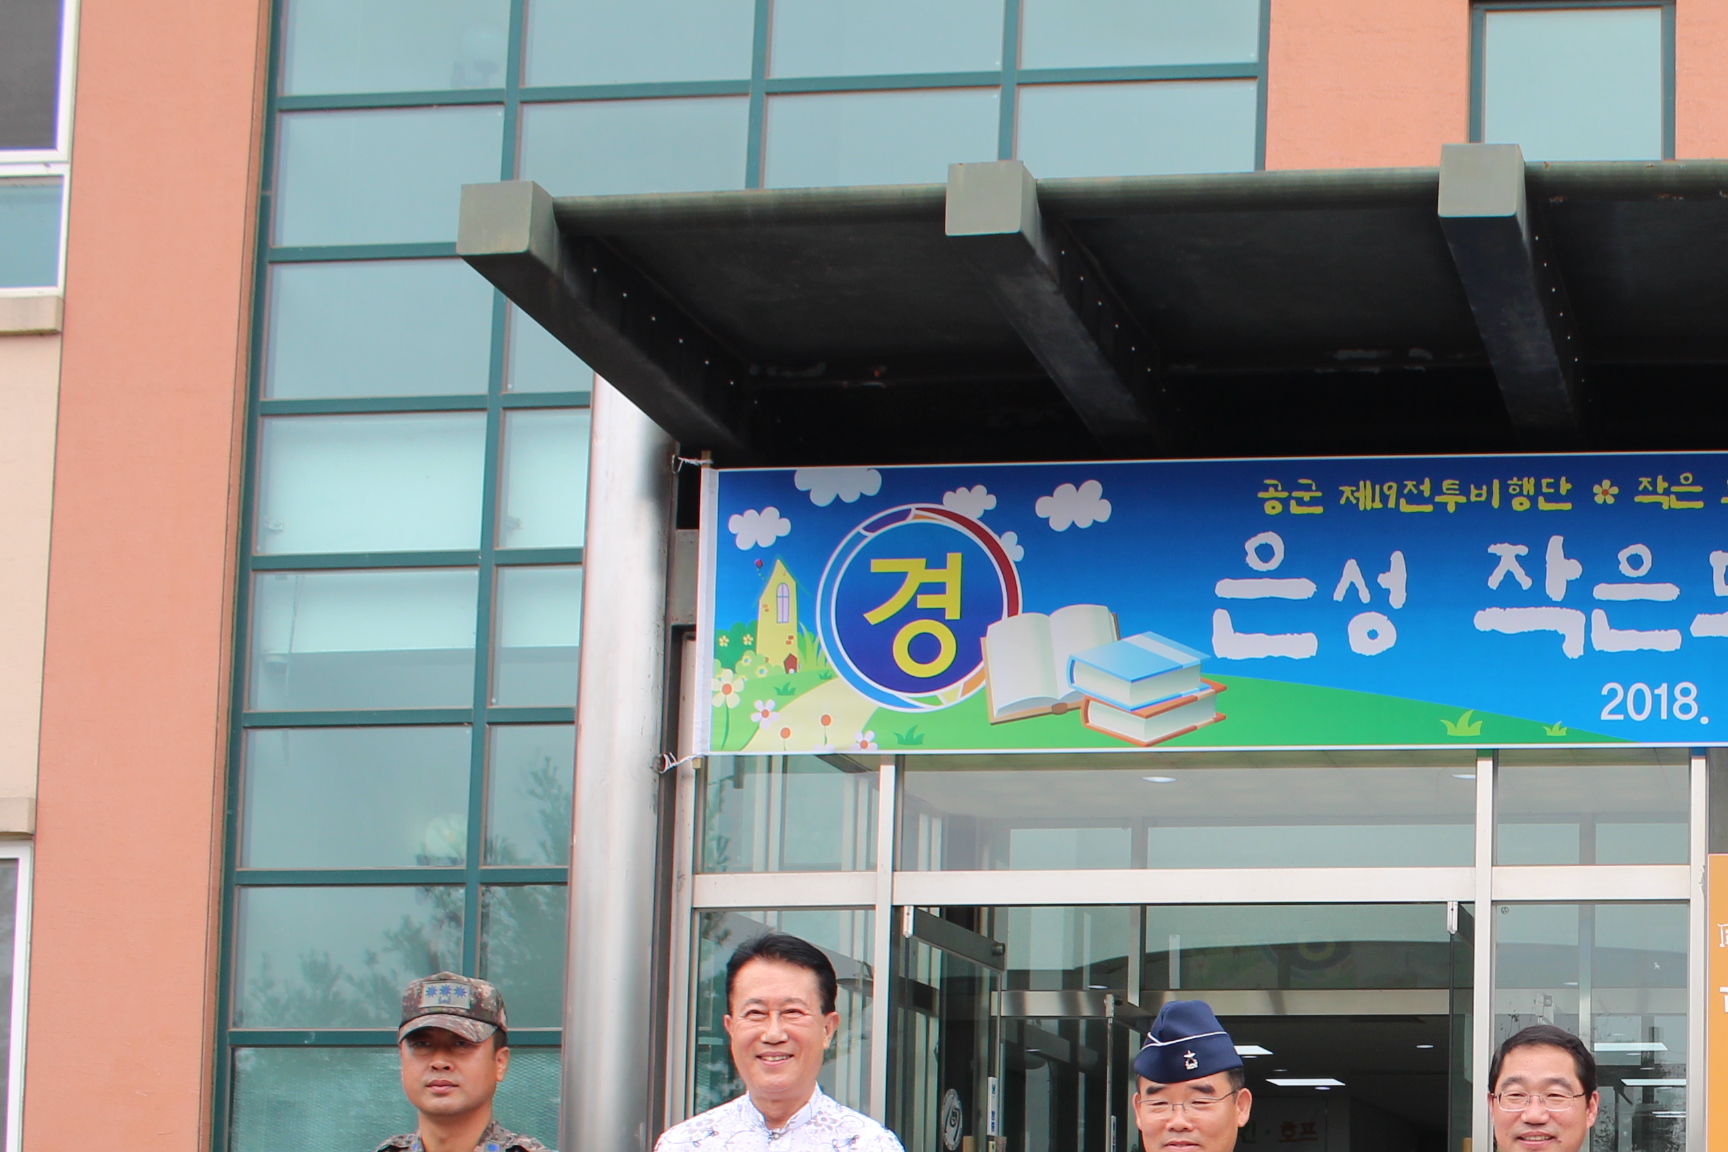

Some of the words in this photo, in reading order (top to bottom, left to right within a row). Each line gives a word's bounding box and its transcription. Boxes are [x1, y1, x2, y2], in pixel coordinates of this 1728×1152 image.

[1257, 478, 1324, 515] 공군
[1339, 476, 1573, 513] 제19전투비행단
[1635, 471, 1705, 509] 작은
[862, 551, 963, 679] 경
[1211, 531, 1407, 660] 은성
[1600, 680, 1709, 725] 2018.
